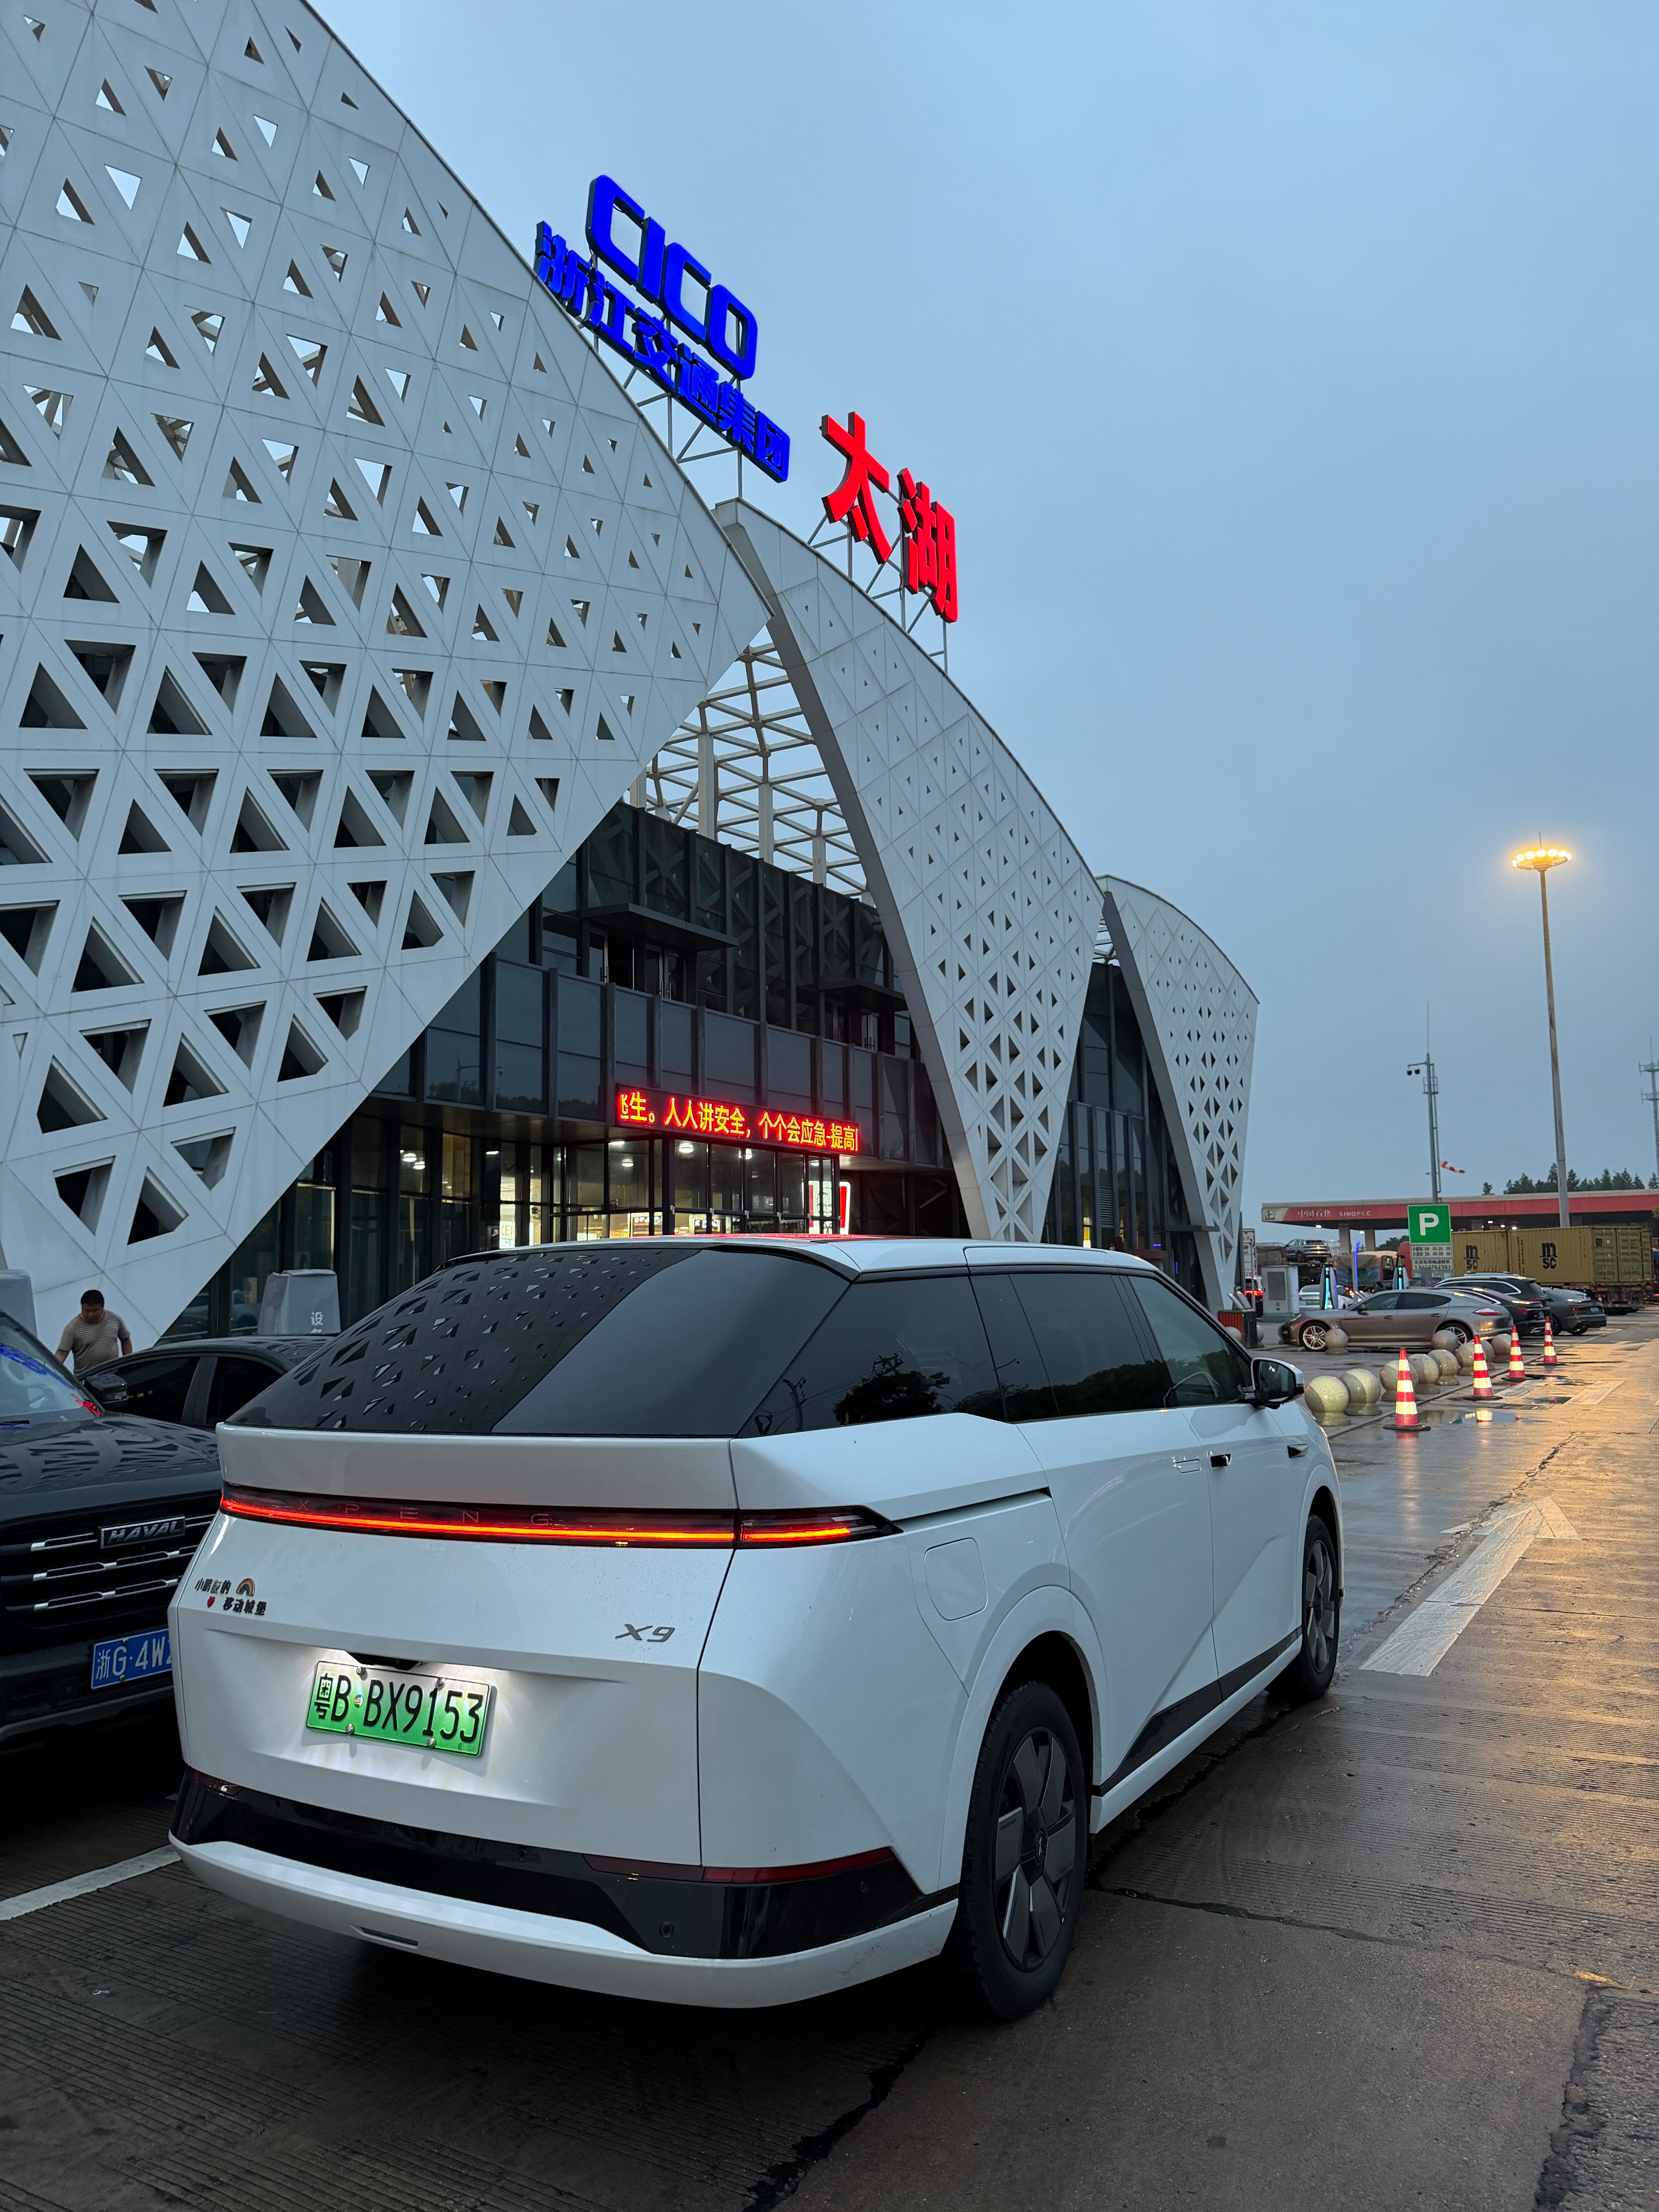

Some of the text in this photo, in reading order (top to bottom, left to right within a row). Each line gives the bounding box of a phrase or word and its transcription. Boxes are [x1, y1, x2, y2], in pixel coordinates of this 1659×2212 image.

[585, 175, 758, 380] CICO
[533, 220, 790, 483] 浙江交通集团
[820, 411, 958, 623] 太湖
[1419, 1213, 1439, 1236] P
[108, 1520, 182, 1543] HAVAL
[223, 1597, 267, 1615] 移动城堡
[615, 1623, 675, 1642] X9
